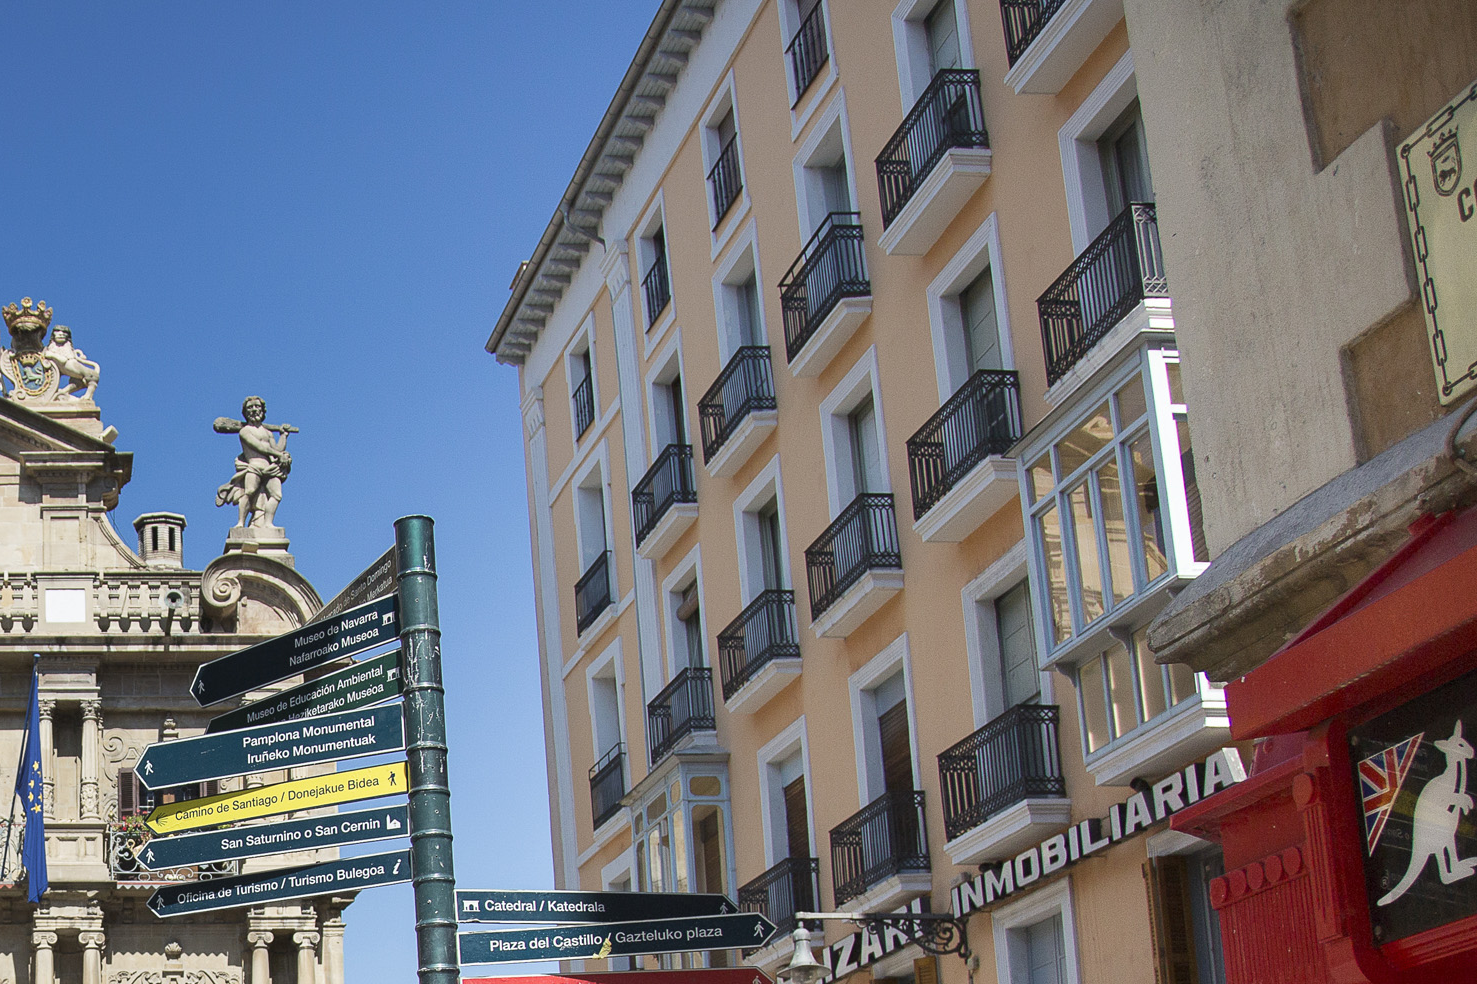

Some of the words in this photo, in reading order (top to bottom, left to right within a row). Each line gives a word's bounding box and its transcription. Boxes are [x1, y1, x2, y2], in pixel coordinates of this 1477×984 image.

[1457, 178, 1477, 222] C
[350, 582, 366, 600] Santo
[366, 560, 392, 586] Domingo
[366, 576, 392, 601] Merkatua
[289, 643, 339, 667] Nafarroako
[341, 628, 379, 648] Museoa
[294, 631, 325, 648] Museo
[327, 625, 339, 636] de
[341, 611, 378, 632] Navarra
[246, 706, 274, 724] Museo
[276, 699, 288, 712] de
[290, 681, 335, 707] Educación
[337, 664, 383, 690] Ambiental
[347, 683, 384, 704] Museoa
[242, 730, 300, 748] Pamplona
[302, 716, 375, 738] Monumental
[247, 748, 290, 764] Iruñeko
[292, 733, 376, 757] Monumentuak
[175, 805, 214, 821] Camino
[216, 802, 230, 814] de
[232, 793, 278, 811] Santiago
[288, 782, 344, 802] Donejakue
[348, 776, 380, 790] Bidea
[221, 837, 243, 850] San
[246, 830, 302, 847] Saturnino
[304, 830, 312, 838] o
[315, 825, 338, 838] San
[341, 818, 380, 834] Cernin
[951, 747, 1248, 919] INMOBILIARIA
[178, 890, 215, 904] Oficina
[218, 888, 232, 898] de
[234, 882, 278, 896] Turismo
[289, 872, 334, 888] Turismo
[337, 864, 385, 882] Bulegoa
[484, 900, 536, 912] Catedral
[548, 900, 606, 912] Katedrala
[490, 940, 526, 952] Plaza
[529, 936, 550, 950] del
[552, 934, 602, 948] Castillo
[615, 929, 682, 944] Gazteluko
[686, 927, 722, 941] plaza
